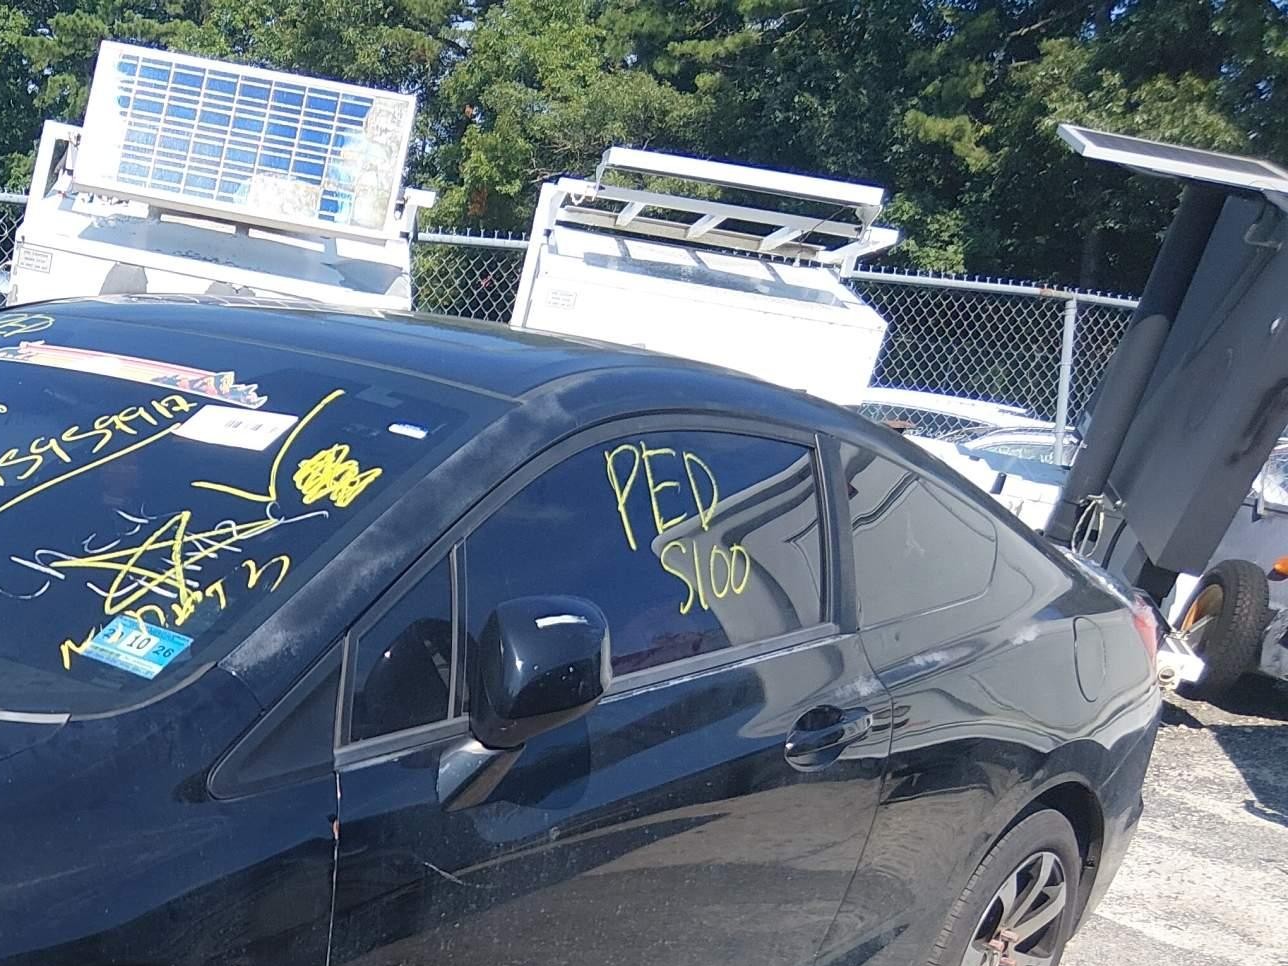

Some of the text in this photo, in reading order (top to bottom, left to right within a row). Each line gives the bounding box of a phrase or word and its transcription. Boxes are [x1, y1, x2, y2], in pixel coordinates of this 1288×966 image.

[604, 440, 719, 551] PED
[126, 634, 152, 651] 10
[152, 644, 175, 659] 26
